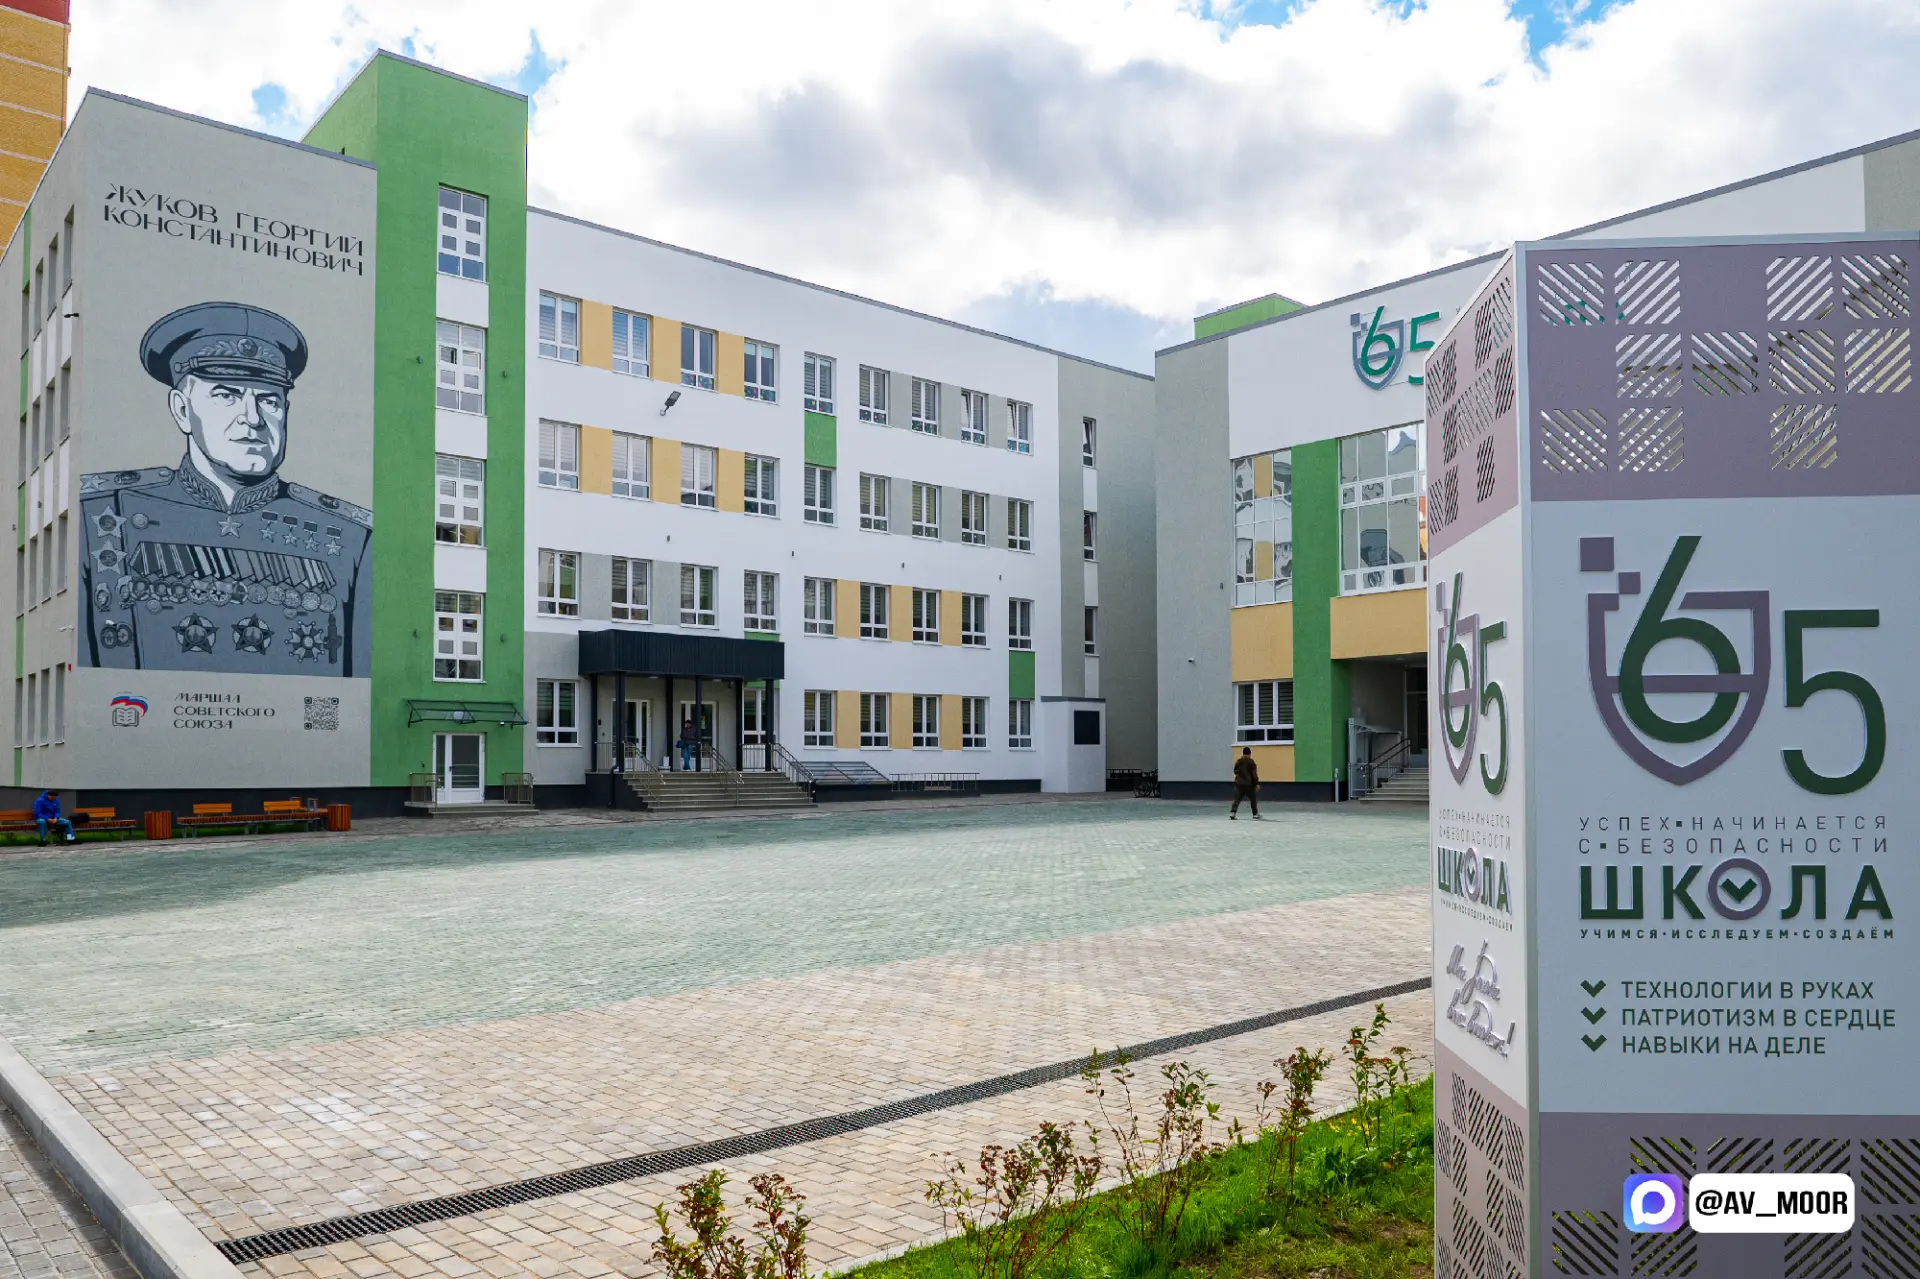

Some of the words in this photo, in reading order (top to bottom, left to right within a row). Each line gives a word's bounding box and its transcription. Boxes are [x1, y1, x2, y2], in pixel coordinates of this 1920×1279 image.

[105, 183, 218, 224] ЖУКОВ
[236, 211, 363, 257] ГЕОРГИЙ
[104, 204, 363, 276] КОНСТАНТИНОВИЧ
[1619, 535, 1887, 796] 65
[174, 692, 241, 704] МАРШАЛ
[173, 705, 276, 717] СОВЕТСКОГО
[173, 718, 233, 730] СОЮЗА
[1437, 846, 1513, 915] ШКОЛА
[1579, 857, 1894, 921] ШКОЛА
[1621, 981, 1772, 999] ТЕХНОЛОГИИ
[1780, 981, 1794, 999] В
[1802, 981, 1875, 999] РУКАХ
[1621, 1008, 1775, 1027] ПАТРИОТИЗМ
[1783, 1008, 1796, 1027] В
[1804, 1008, 1896, 1030] СЕРДЦЕ
[1622, 1036, 1720, 1054] НАВЫКИ
[1729, 1036, 1758, 1054] НА
[1764, 1036, 1826, 1057] ДЕЛЕ
